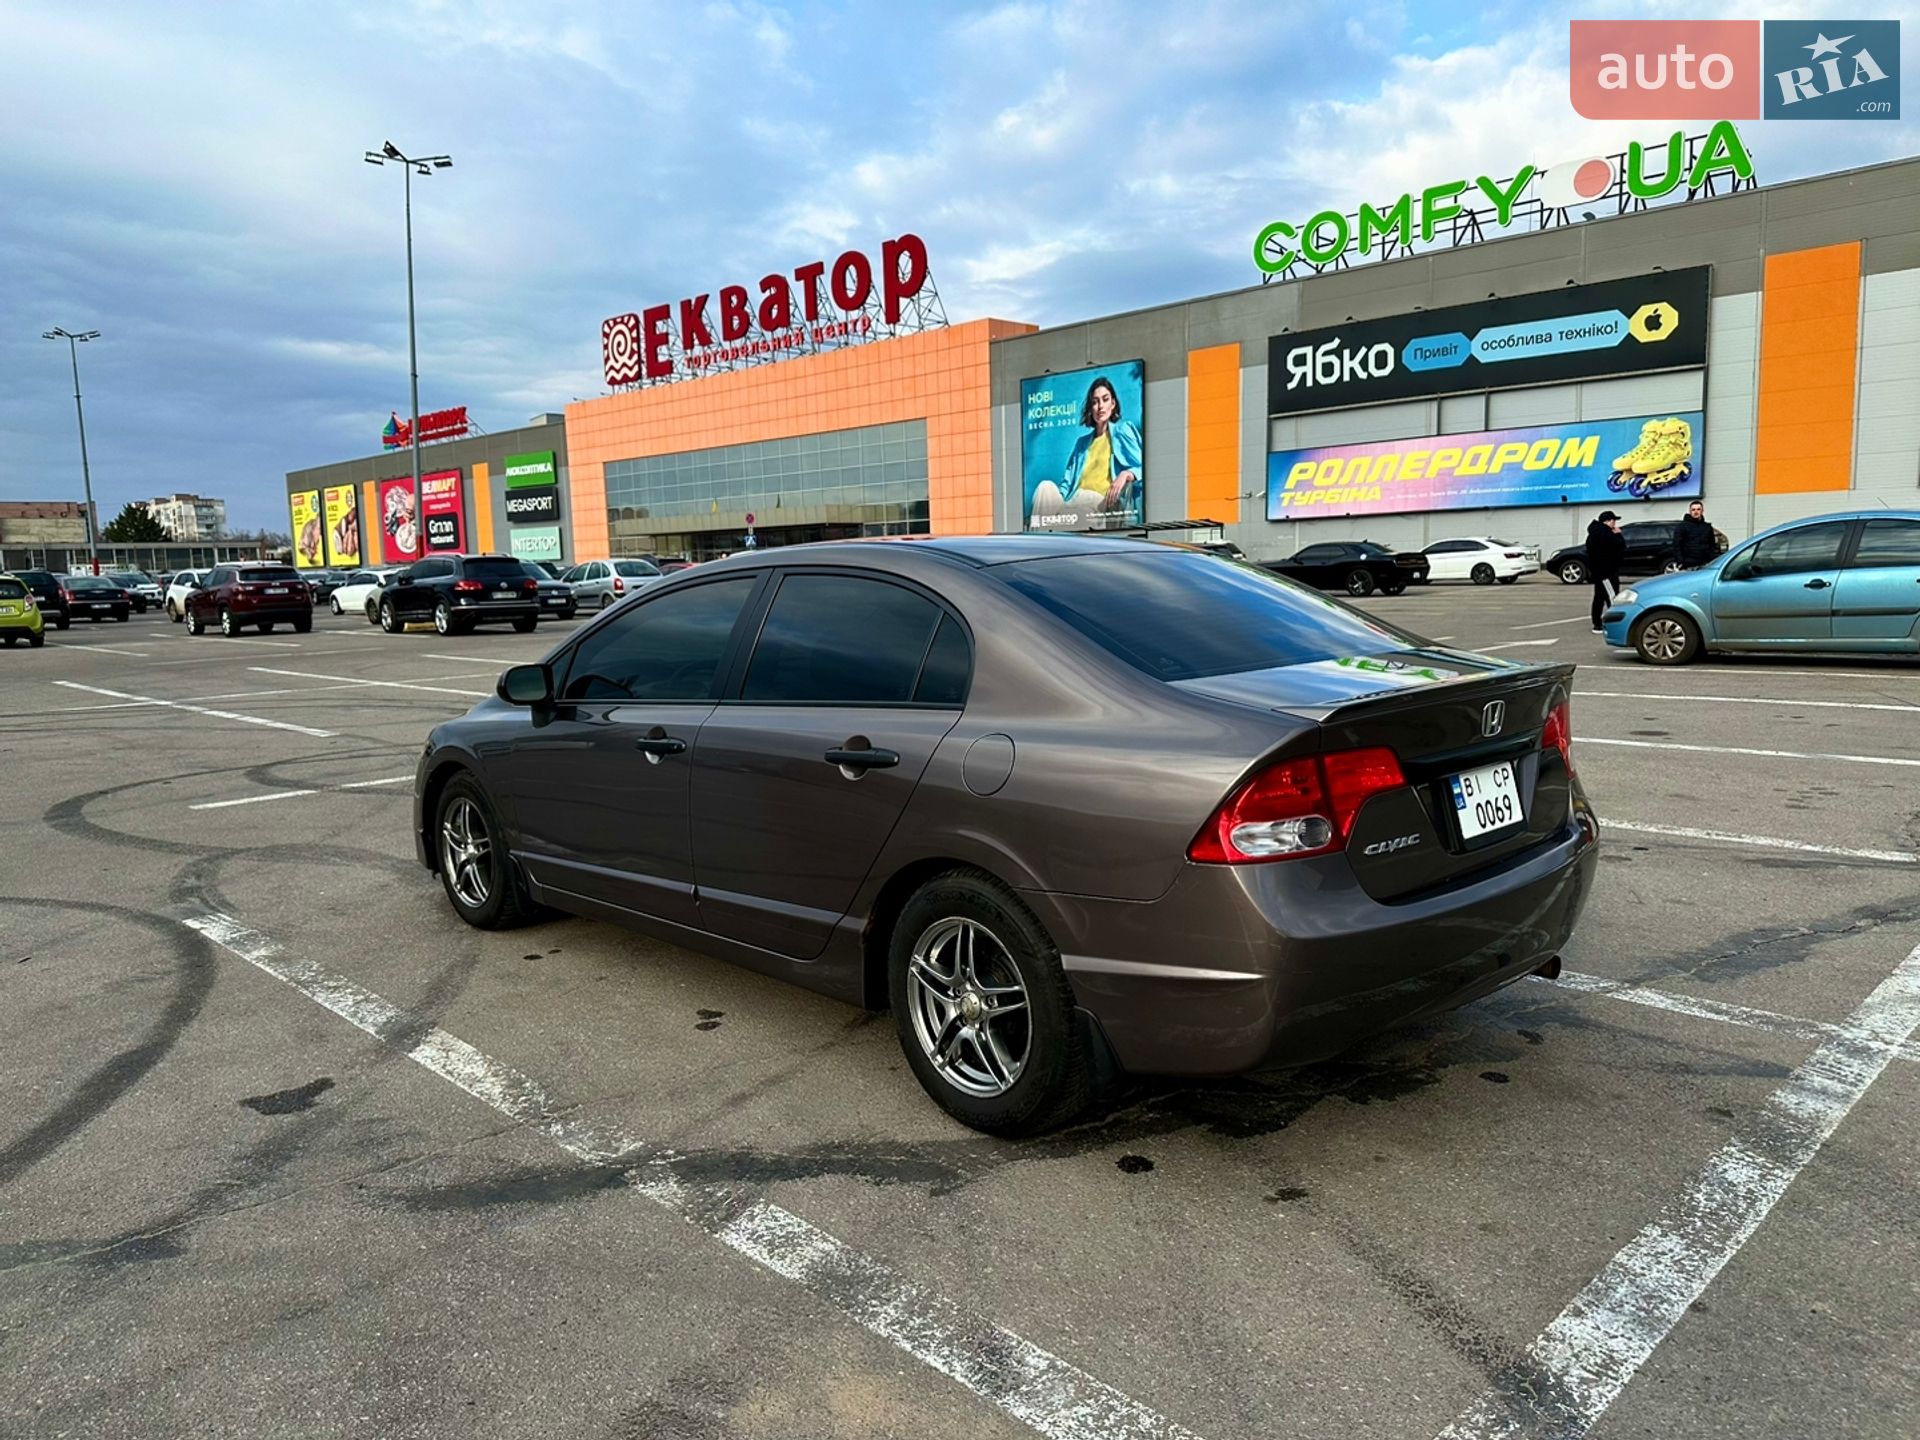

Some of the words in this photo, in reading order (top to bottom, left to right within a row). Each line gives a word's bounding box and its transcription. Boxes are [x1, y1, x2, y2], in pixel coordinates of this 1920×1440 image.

[1253, 164, 1538, 275] COMFY
[684, 327, 805, 368] торговельний
[811, 315, 872, 343] центр
[1286, 337, 1395, 391] Ябко
[1414, 342, 1459, 362] Привіт
[1480, 329, 1553, 353] особлива
[1557, 321, 1619, 342] техніко!
[1028, 391, 1054, 405] НОВІ
[1028, 401, 1077, 419] КОЛЕКЦІЇ
[1284, 434, 1601, 490] РОЛЛЕРДРОМ
[506, 496, 553, 512] MEGASPORT
[1280, 484, 1382, 507] ТУРБІНА
[513, 535, 557, 552] INTERTOP
[1475, 795, 1512, 829] 0069
[1364, 833, 1421, 856] CIVIC
